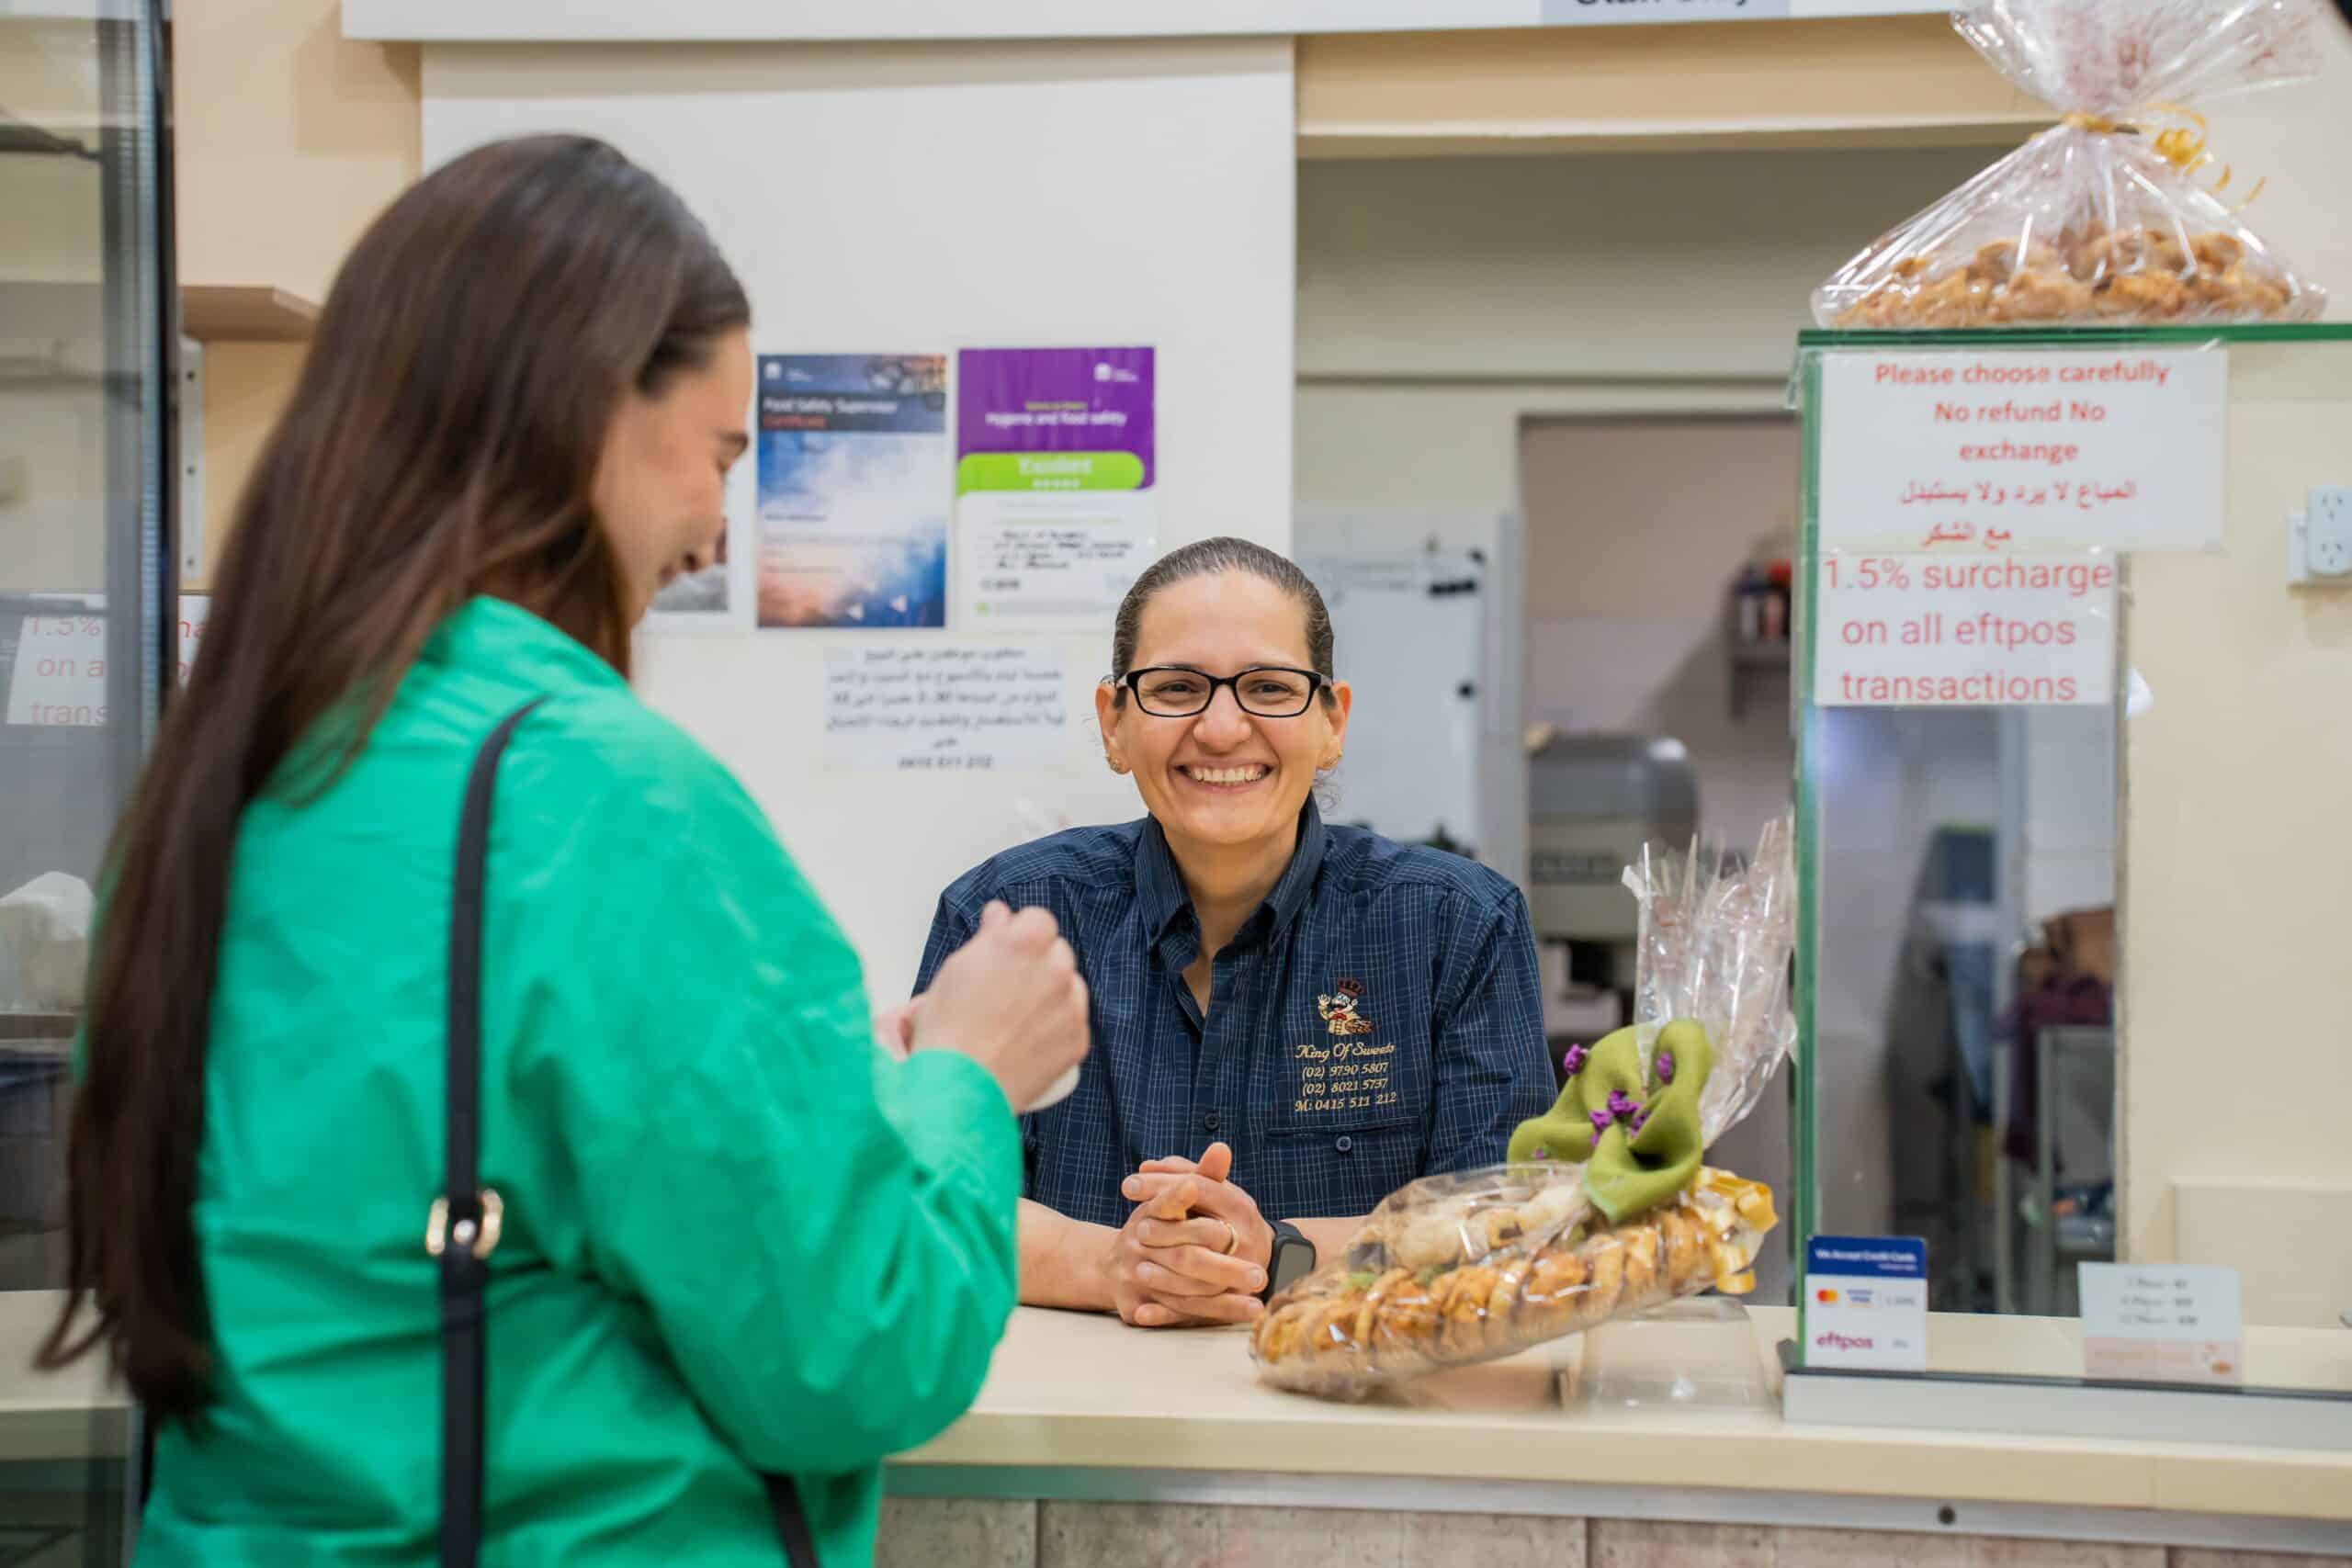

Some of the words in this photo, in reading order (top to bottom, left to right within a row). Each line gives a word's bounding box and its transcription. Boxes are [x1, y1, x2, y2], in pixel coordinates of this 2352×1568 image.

[1875, 363, 1955, 383] Please
[1962, 362, 2051, 383] choose
[2058, 360, 2170, 387] carefully
[1935, 401, 1970, 422] No
[1977, 399, 2062, 422] refund
[2069, 400, 2106, 422] No
[1959, 440, 2079, 464] exchange
[2053, 481, 2070, 502] لا
[1984, 525, 2011, 548] مع
[1825, 558, 1910, 590] 1.5%
[1923, 558, 2113, 597] surcharge
[1841, 619, 1886, 645] on
[1901, 613, 1942, 645] all
[1955, 613, 2076, 651] eftpos
[36, 659, 75, 678] on
[1841, 670, 2076, 701] transactions
[1295, 1044, 1329, 1063] King
[1333, 1043, 1353, 1061] Of
[1352, 1041, 1395, 1056] Sweets
[1302, 1066, 1325, 1080] (02)
[1329, 1065, 1358, 1077] 9790
[1302, 1082, 1326, 1097] (02)
[1330, 1080, 1359, 1092] 8021
[1315, 1099, 1344, 1111] 0415
[1350, 1097, 1371, 1109] 511
[1375, 1092, 1396, 1105] 212
[1816, 1331, 1873, 1351] eftpos
